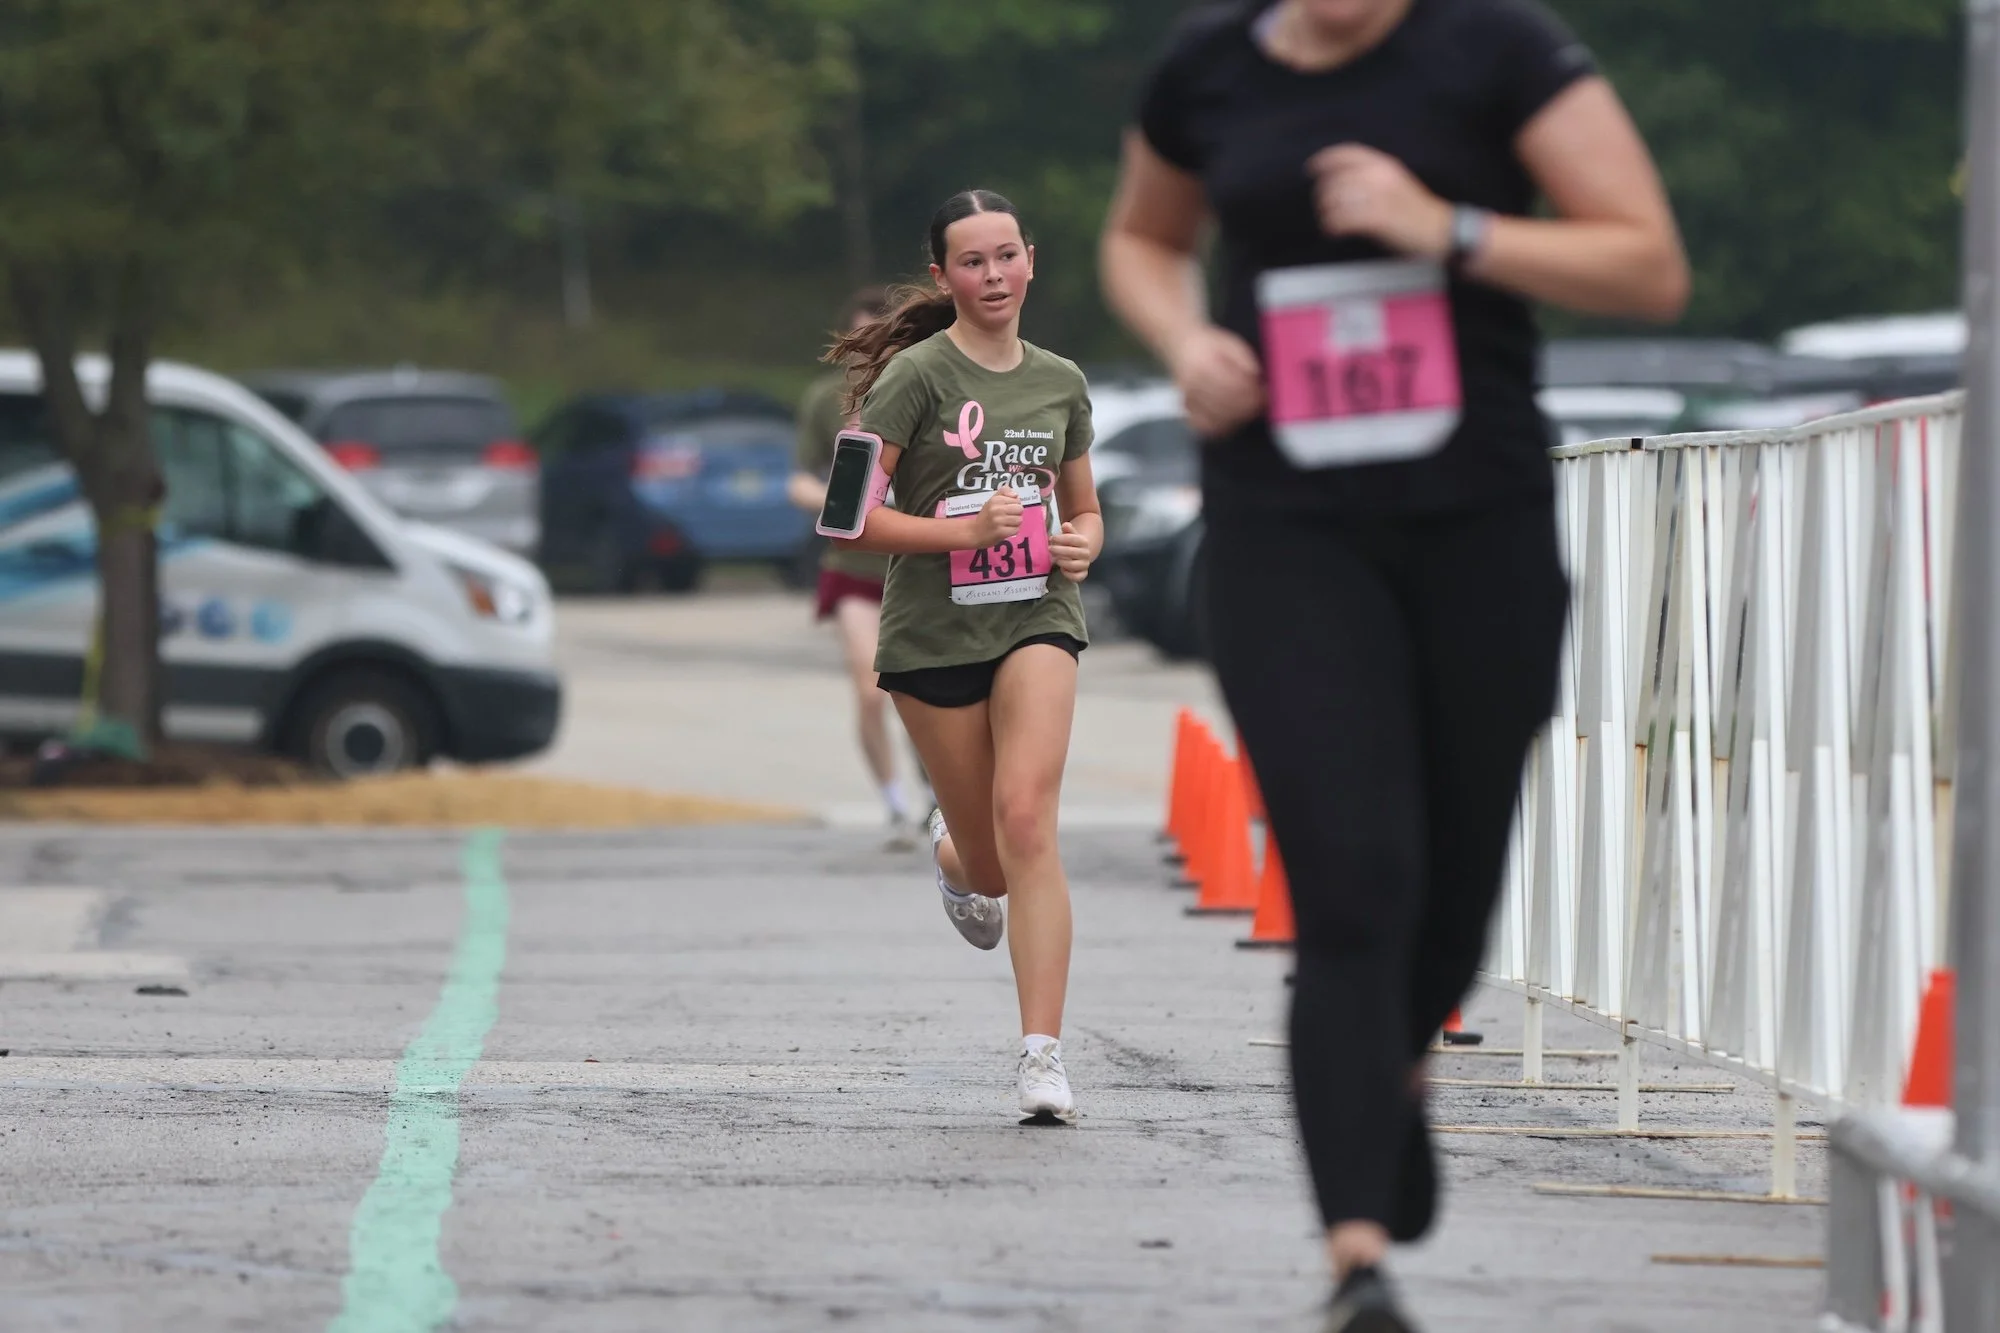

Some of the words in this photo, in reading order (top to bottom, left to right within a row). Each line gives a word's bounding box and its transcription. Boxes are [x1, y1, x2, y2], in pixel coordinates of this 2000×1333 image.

[1004, 429, 1025, 438] 22nd
[1026, 429, 1054, 439] Annual
[979, 440, 1048, 473] Race
[957, 461, 1037, 491] Grace
[969, 537, 1034, 580] 431
